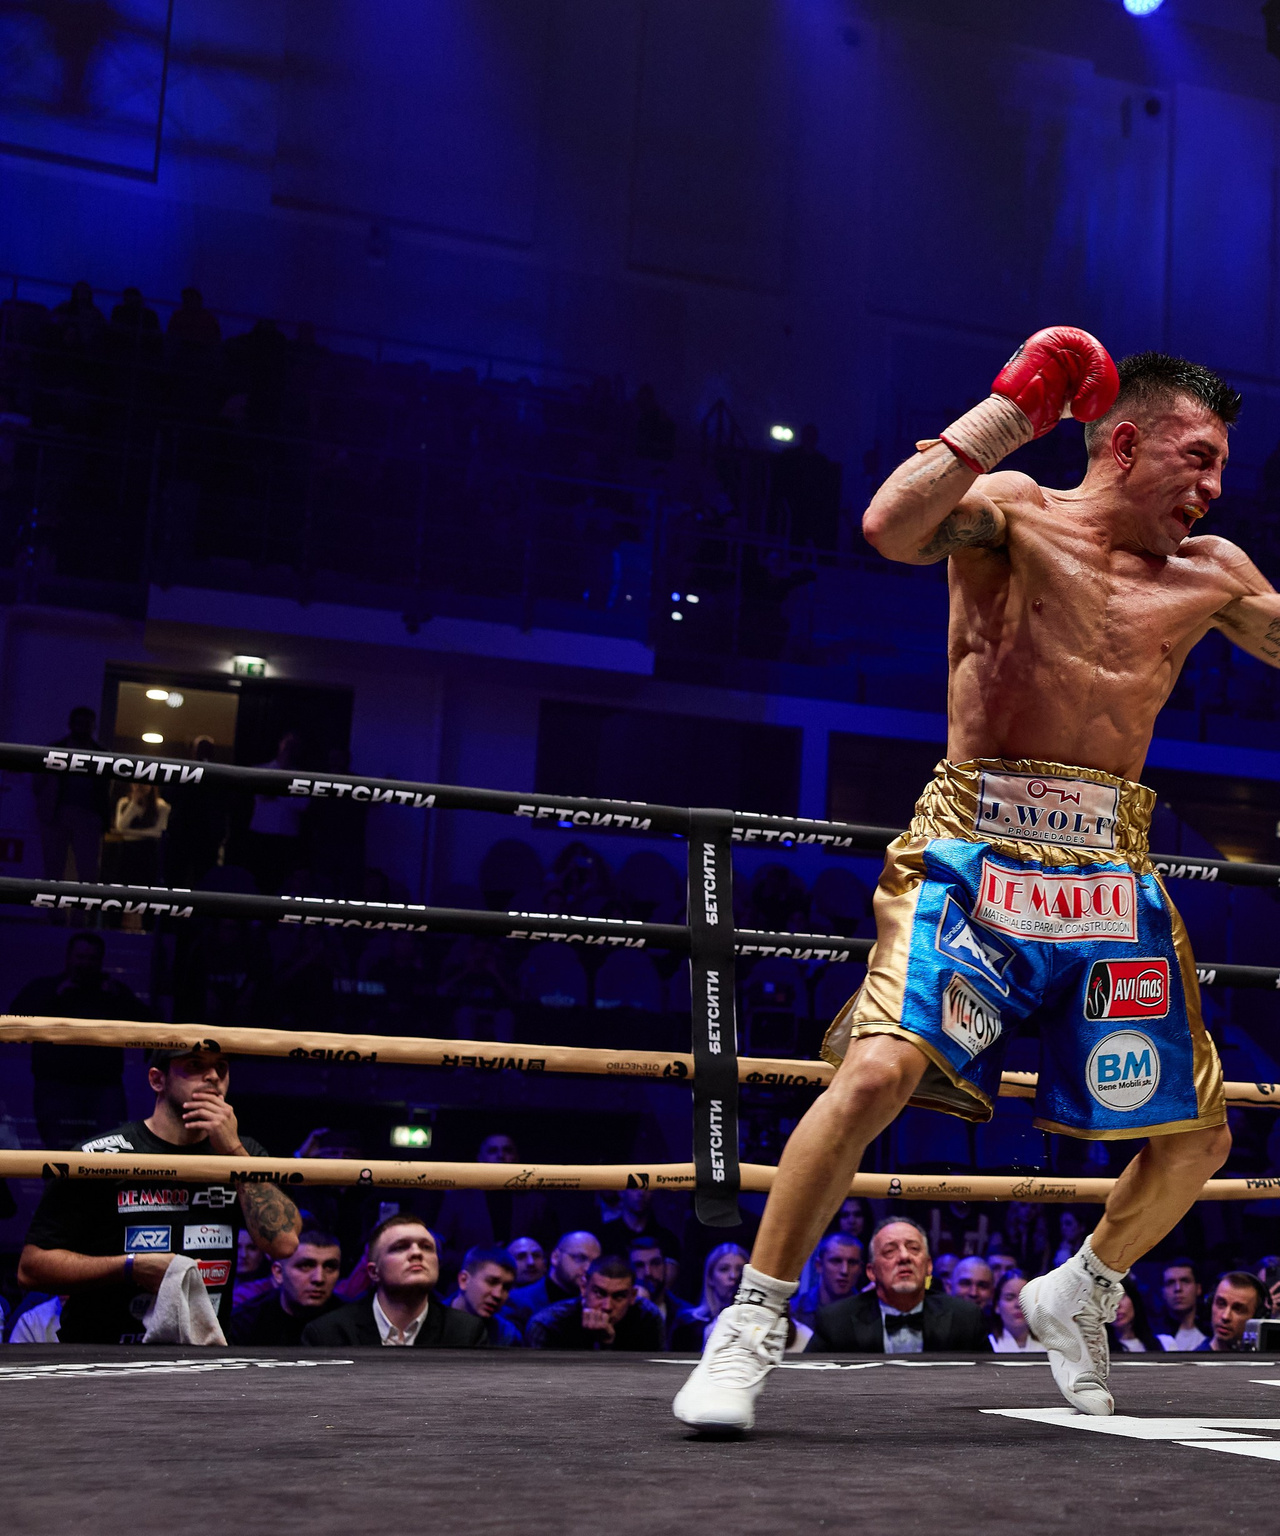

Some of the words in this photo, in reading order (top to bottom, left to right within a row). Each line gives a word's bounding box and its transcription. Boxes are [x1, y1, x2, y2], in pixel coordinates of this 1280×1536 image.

[43, 751, 204, 783] БЕТСИТИ
[288, 779, 436, 808] БЕТСИТИ
[1007, 827, 1086, 844] PROPIEDADES
[1155, 862, 1219, 882] СИТИ
[706, 843, 715, 926] БЕТСИТИ
[986, 873, 1024, 914] DE
[1028, 883, 1130, 919] MARCO
[983, 907, 1033, 931] MATERIALES
[1033, 922, 1054, 933] PARA
[1054, 923, 1064, 933] LA
[709, 971, 719, 1054] БЕТСИТИ
[441, 1054, 523, 1071] MAER
[606, 1062, 660, 1071] ОТЕЧЕСТВО
[1098, 1049, 1152, 1083] BM
[1098, 1083, 1117, 1091] Bene
[1119, 1081, 1142, 1089] Mobili
[712, 1099, 722, 1182] БЕТСИТИ
[78, 1166, 130, 1176] Бумеранг
[133, 1167, 178, 1176] Капитал
[656, 1175, 696, 1183] Бумеран
[131, 1231, 168, 1247] ARZ
